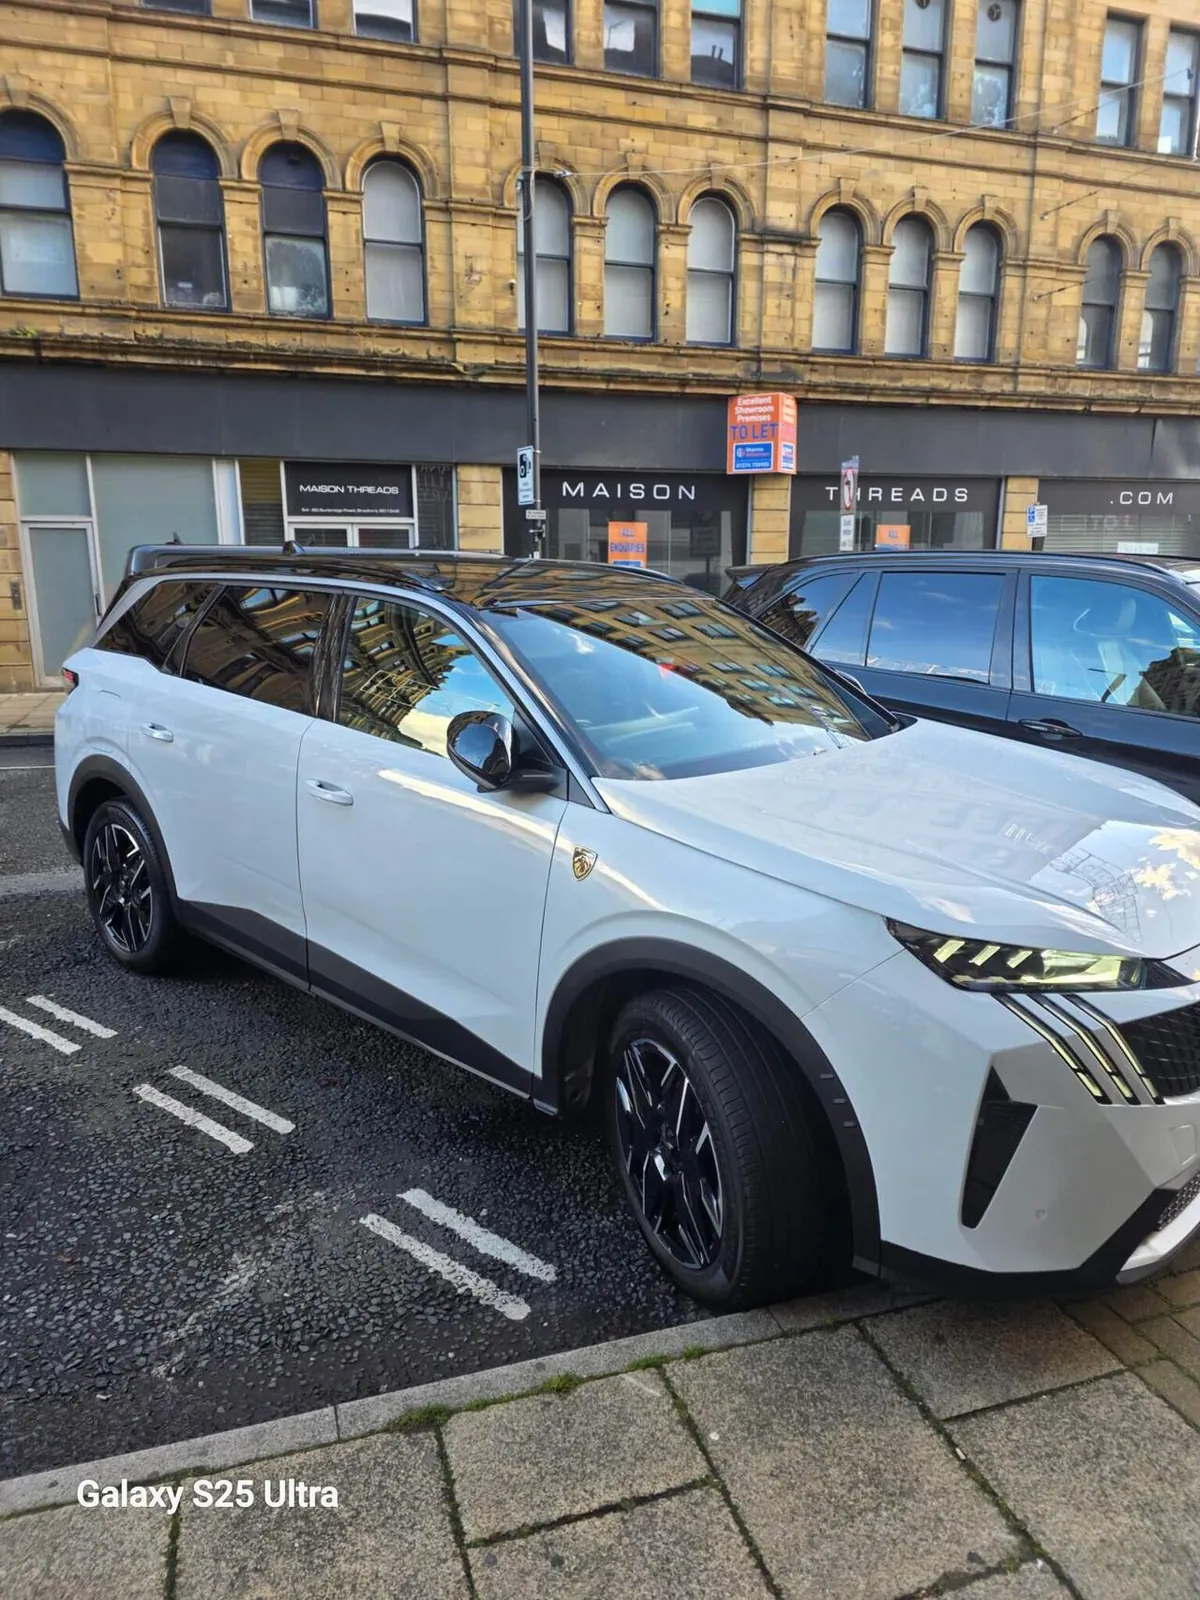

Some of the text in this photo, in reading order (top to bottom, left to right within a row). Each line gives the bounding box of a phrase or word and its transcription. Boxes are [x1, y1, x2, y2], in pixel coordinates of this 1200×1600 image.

[737, 396, 772, 406] Excellent
[734, 405, 775, 415] Showroom
[736, 414, 771, 423] Premises
[730, 423, 779, 441] TO LET
[299, 484, 400, 495] MAISON THREADS
[562, 480, 696, 501] MAISON
[1109, 491, 1174, 505] .COM
